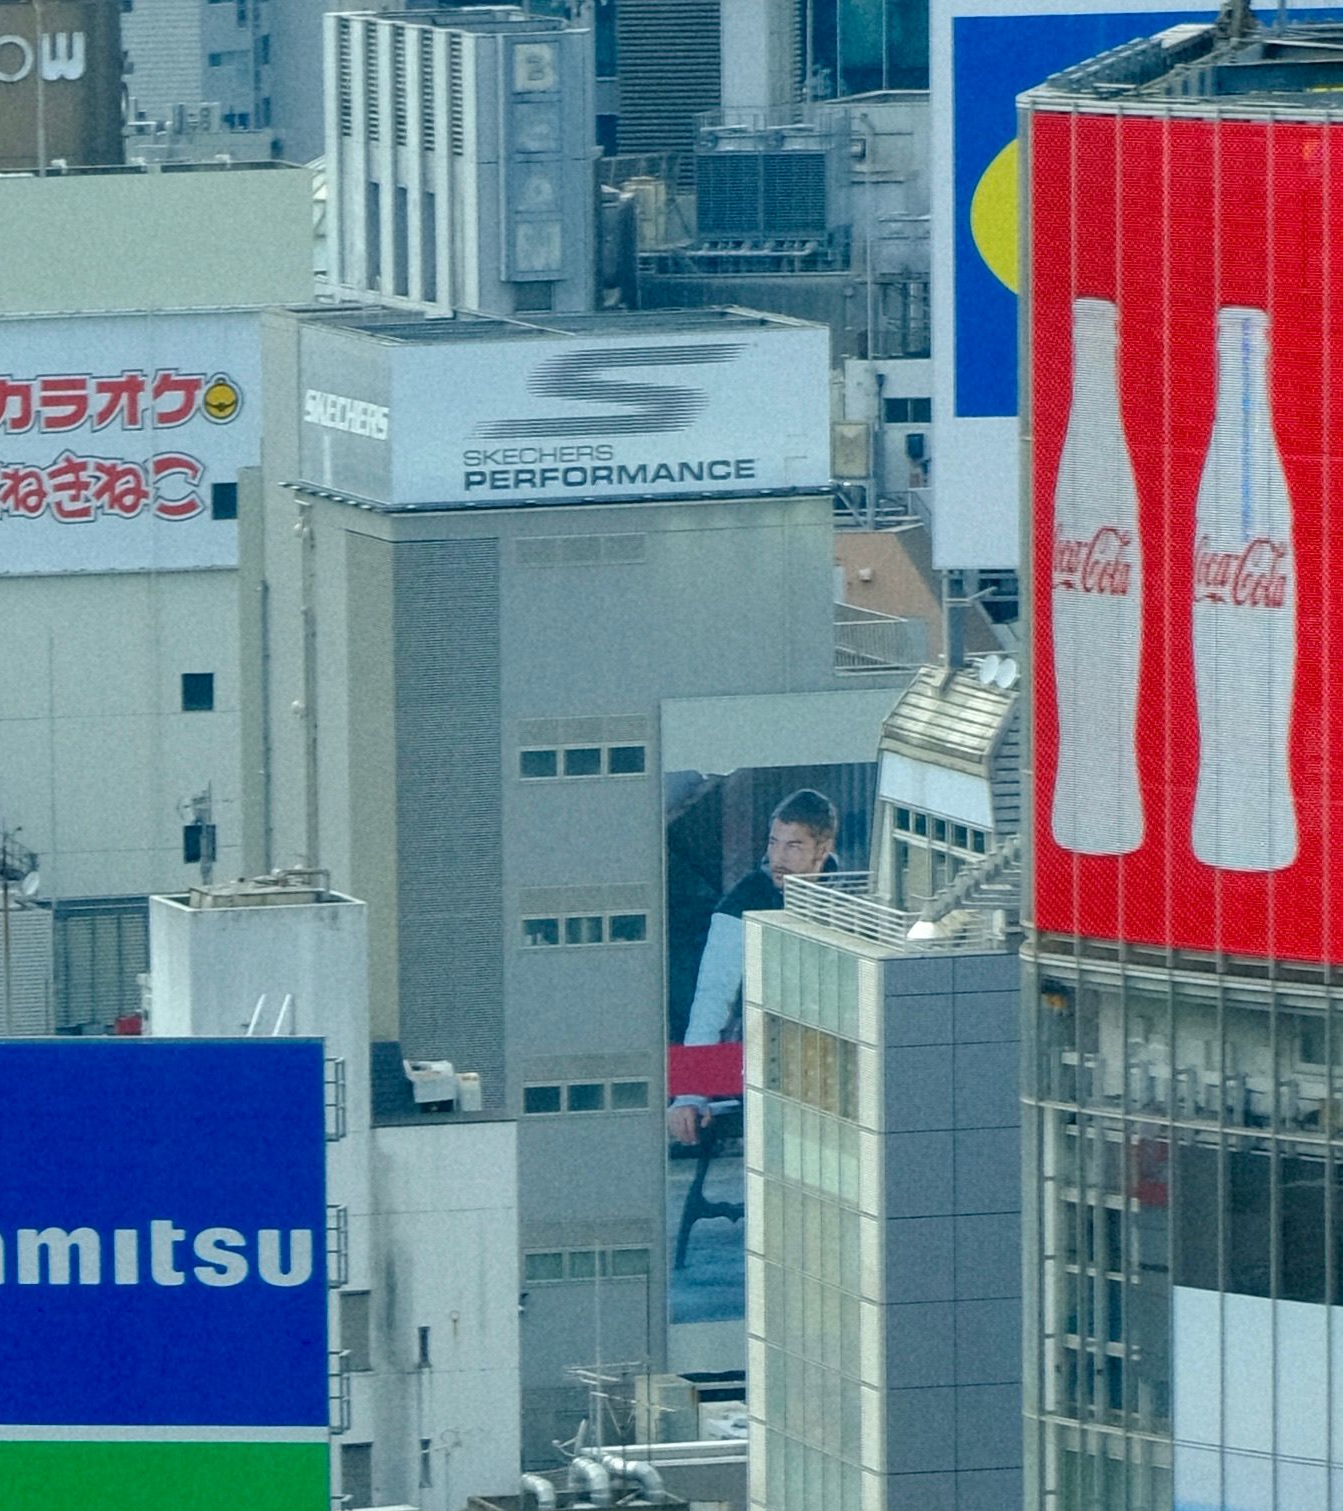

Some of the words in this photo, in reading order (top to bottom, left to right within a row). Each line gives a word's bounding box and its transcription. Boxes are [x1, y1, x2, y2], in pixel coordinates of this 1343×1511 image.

[305, 390, 389, 439] SKECHERS
[464, 444, 613, 467] SKECHERS
[464, 458, 755, 490] PERFORMANCE
